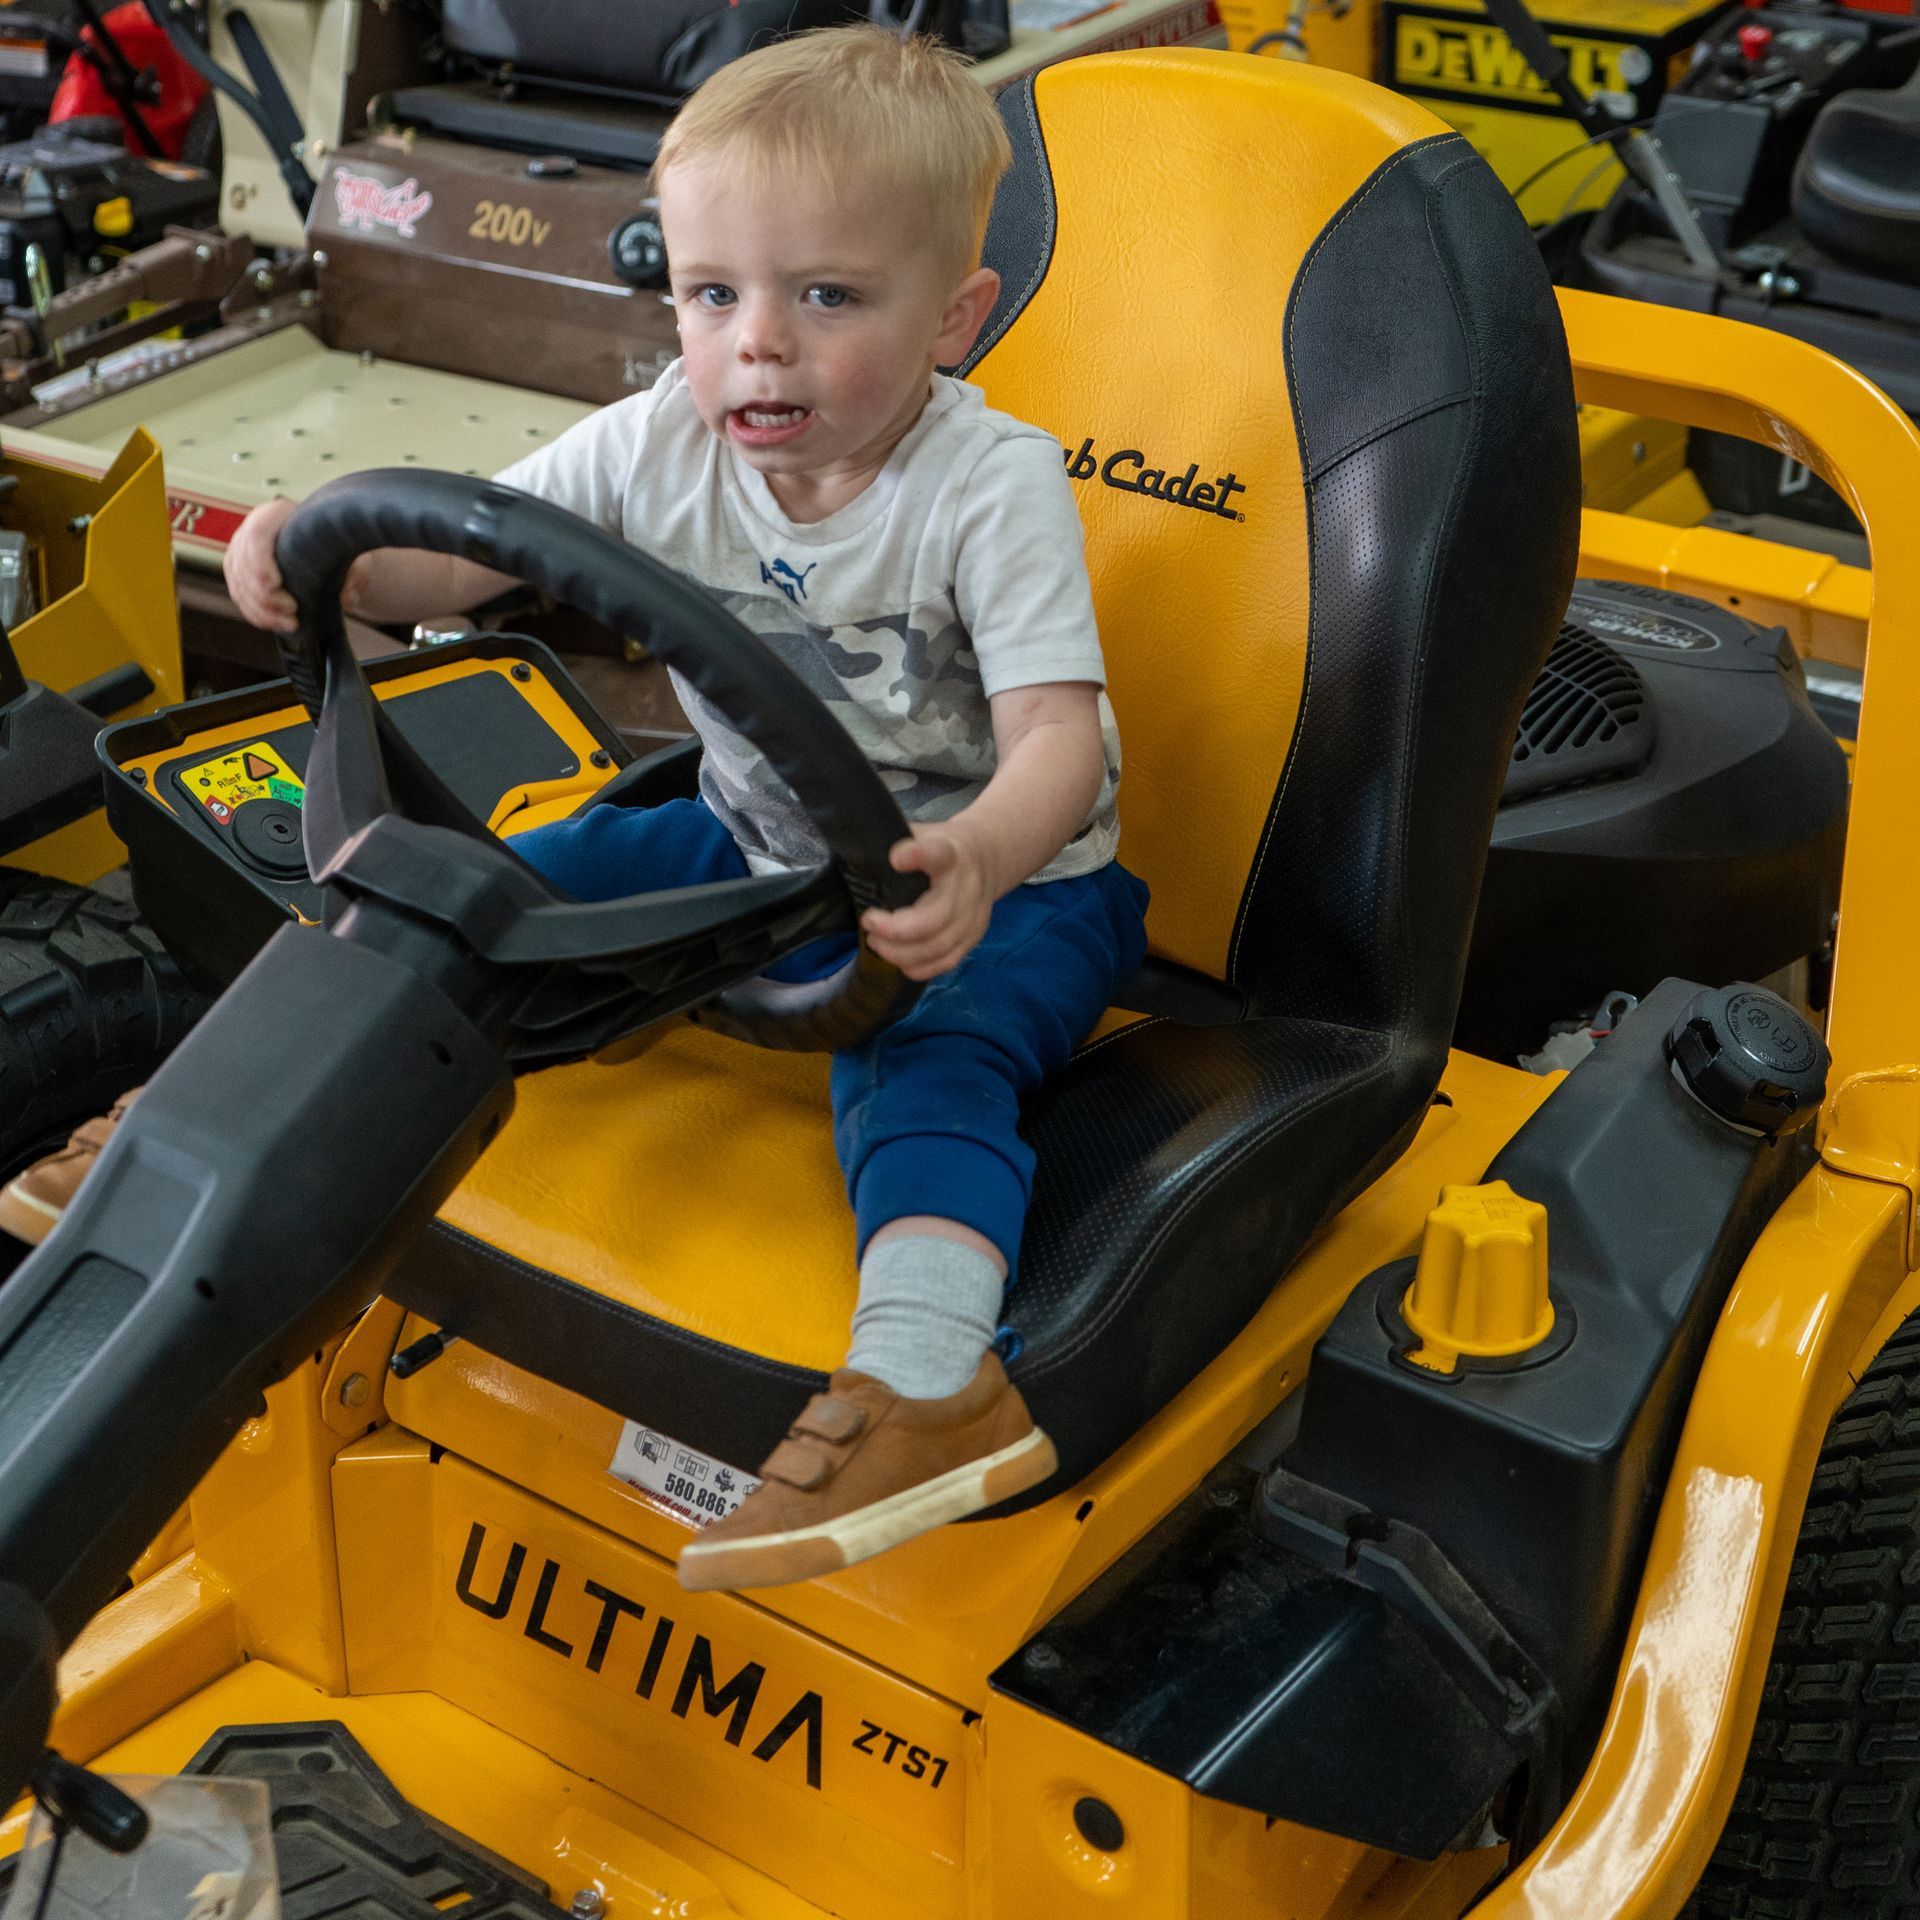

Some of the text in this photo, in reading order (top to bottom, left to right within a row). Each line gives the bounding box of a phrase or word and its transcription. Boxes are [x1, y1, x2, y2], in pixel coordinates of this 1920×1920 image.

[1400, 28, 1628, 101] DEWLT
[1101, 449, 1246, 520] Cadet
[456, 1521, 823, 1791] ULTIMA
[851, 1719, 949, 1789] ZTS1
